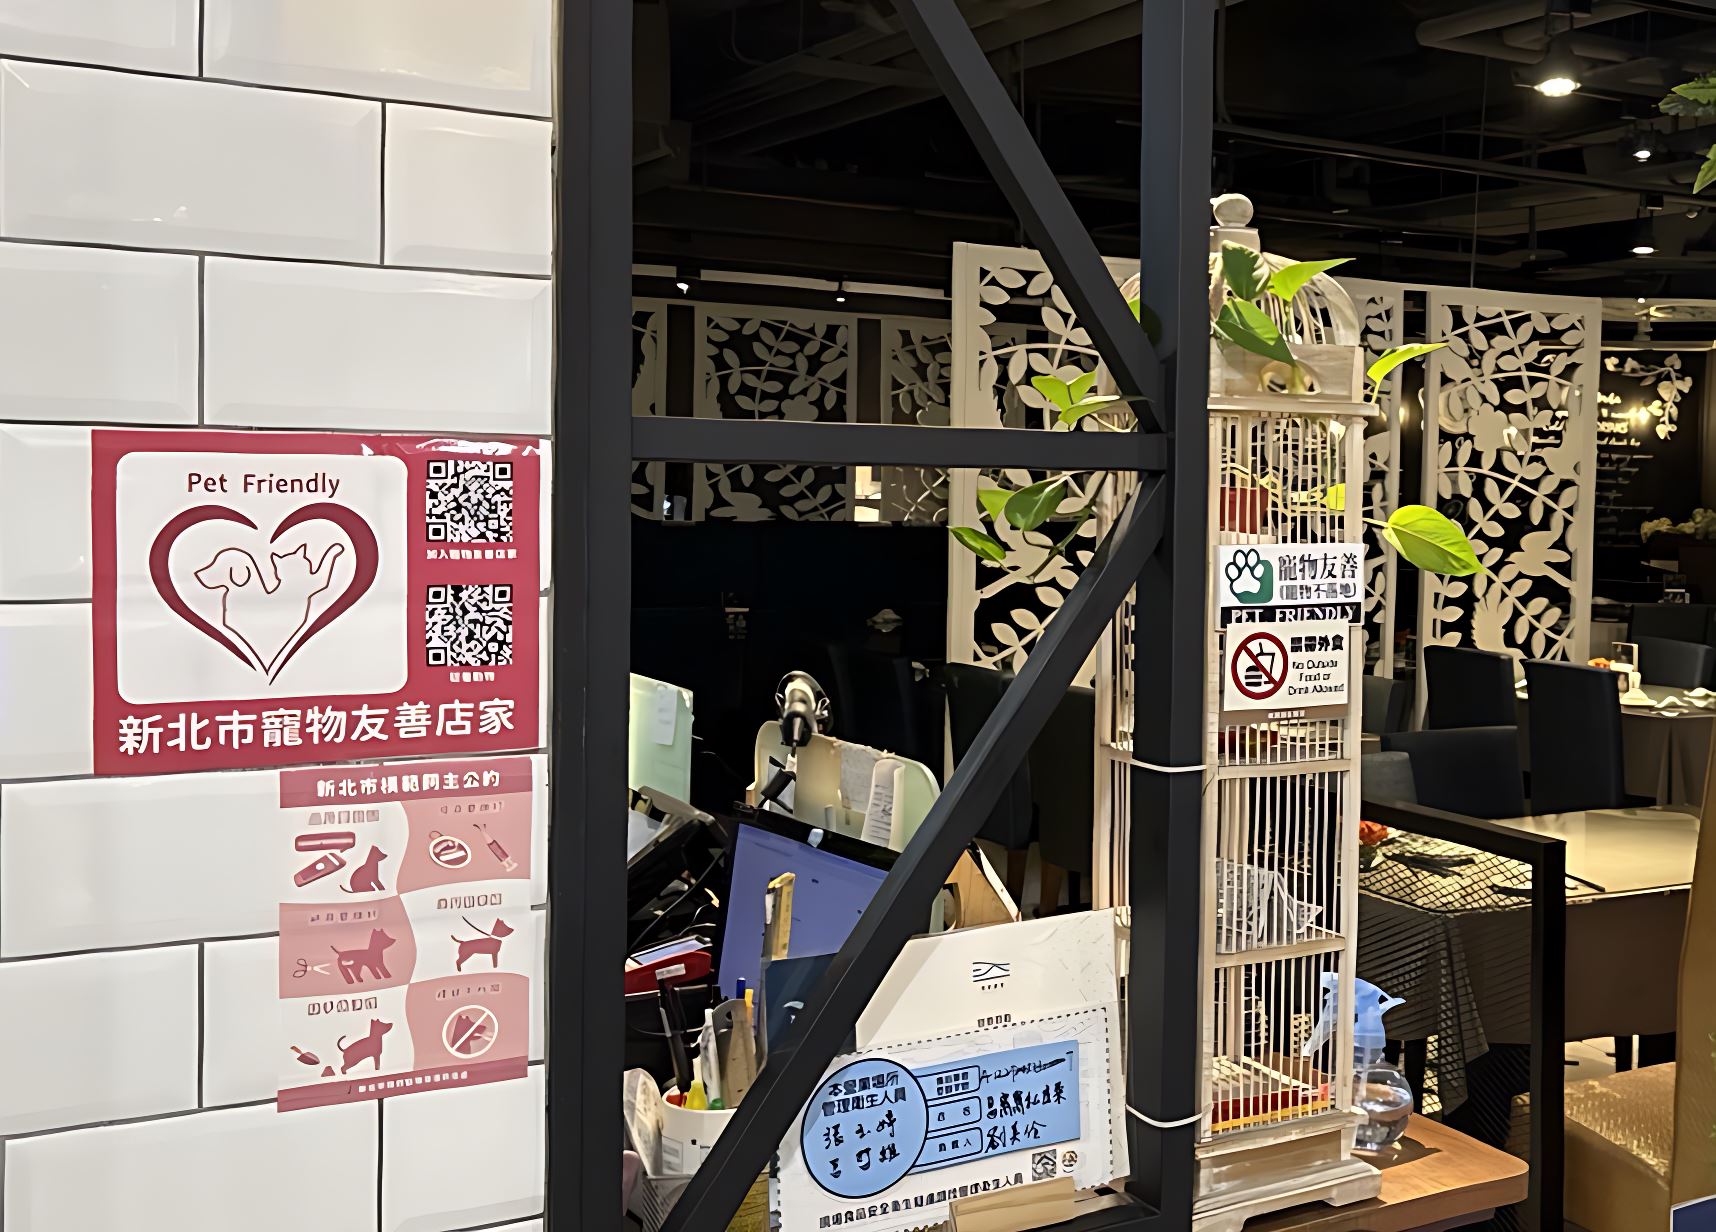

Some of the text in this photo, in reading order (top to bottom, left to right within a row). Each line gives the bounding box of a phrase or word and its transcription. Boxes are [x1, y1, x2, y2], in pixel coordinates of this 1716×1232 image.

[187, 472, 340, 498] Pet Friendly
[1231, 605, 1355, 622] PET FRIENDLY
[118, 697, 516, 756] 新北市寵物友善店家
